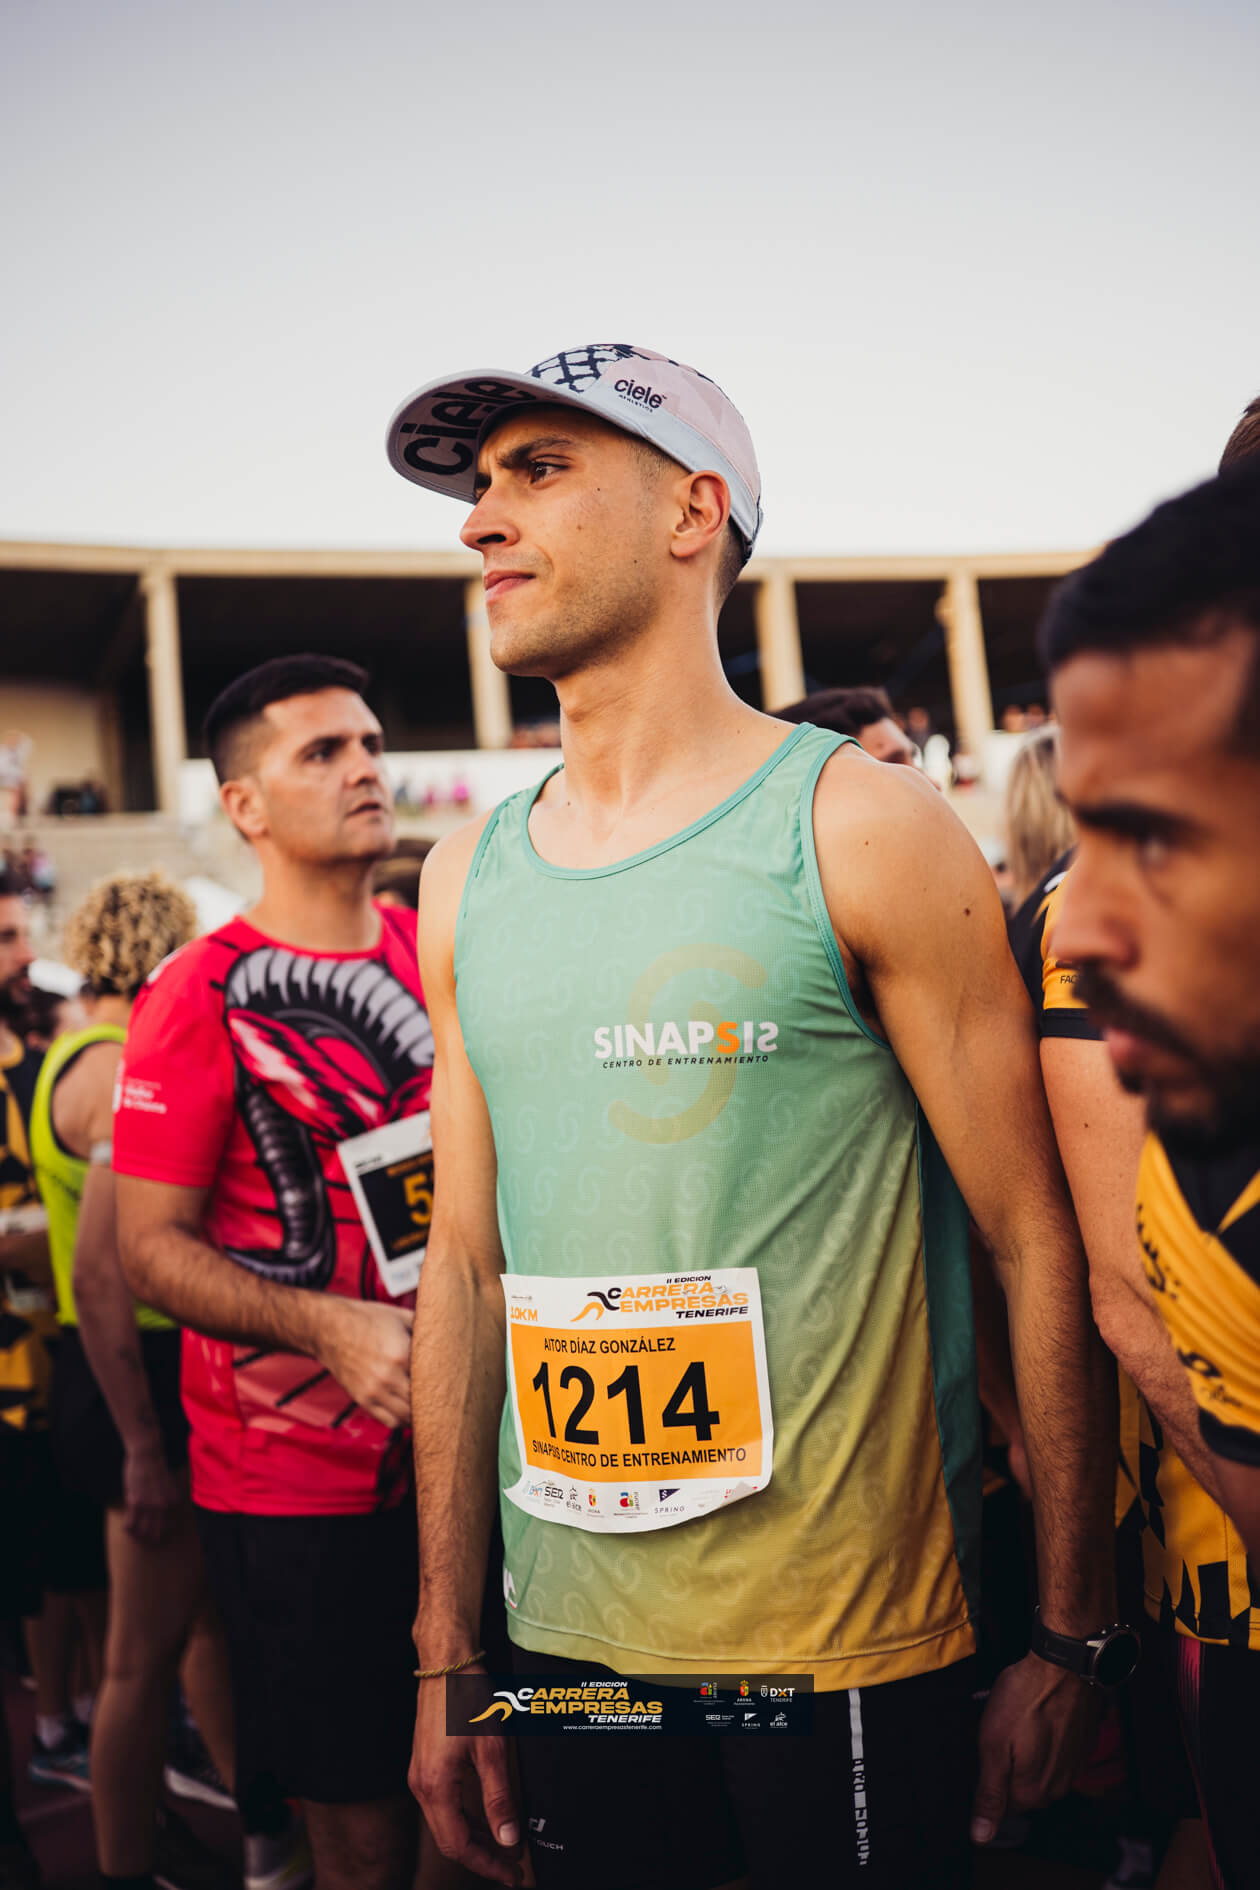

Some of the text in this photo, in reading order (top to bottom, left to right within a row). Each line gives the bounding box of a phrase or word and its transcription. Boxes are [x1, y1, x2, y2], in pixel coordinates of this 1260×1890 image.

[614, 379, 663, 409] ciele
[602, 1055, 769, 1069] CENTRO DE ENTRENAMIENTO
[674, 1275, 711, 1283] EDICION
[607, 1281, 714, 1300] CARRERA
[620, 1292, 749, 1313] EMPRESAS
[676, 1306, 749, 1319] TENERIFE
[544, 1335, 676, 1354] AITOR DÍAZ GONZÁLEZ
[532, 1361, 720, 1446] 1214
[561, 1450, 597, 1467] CENTRO
[600, 1453, 619, 1468] DE
[623, 1447, 747, 1467] ENTRENAMIENTO
